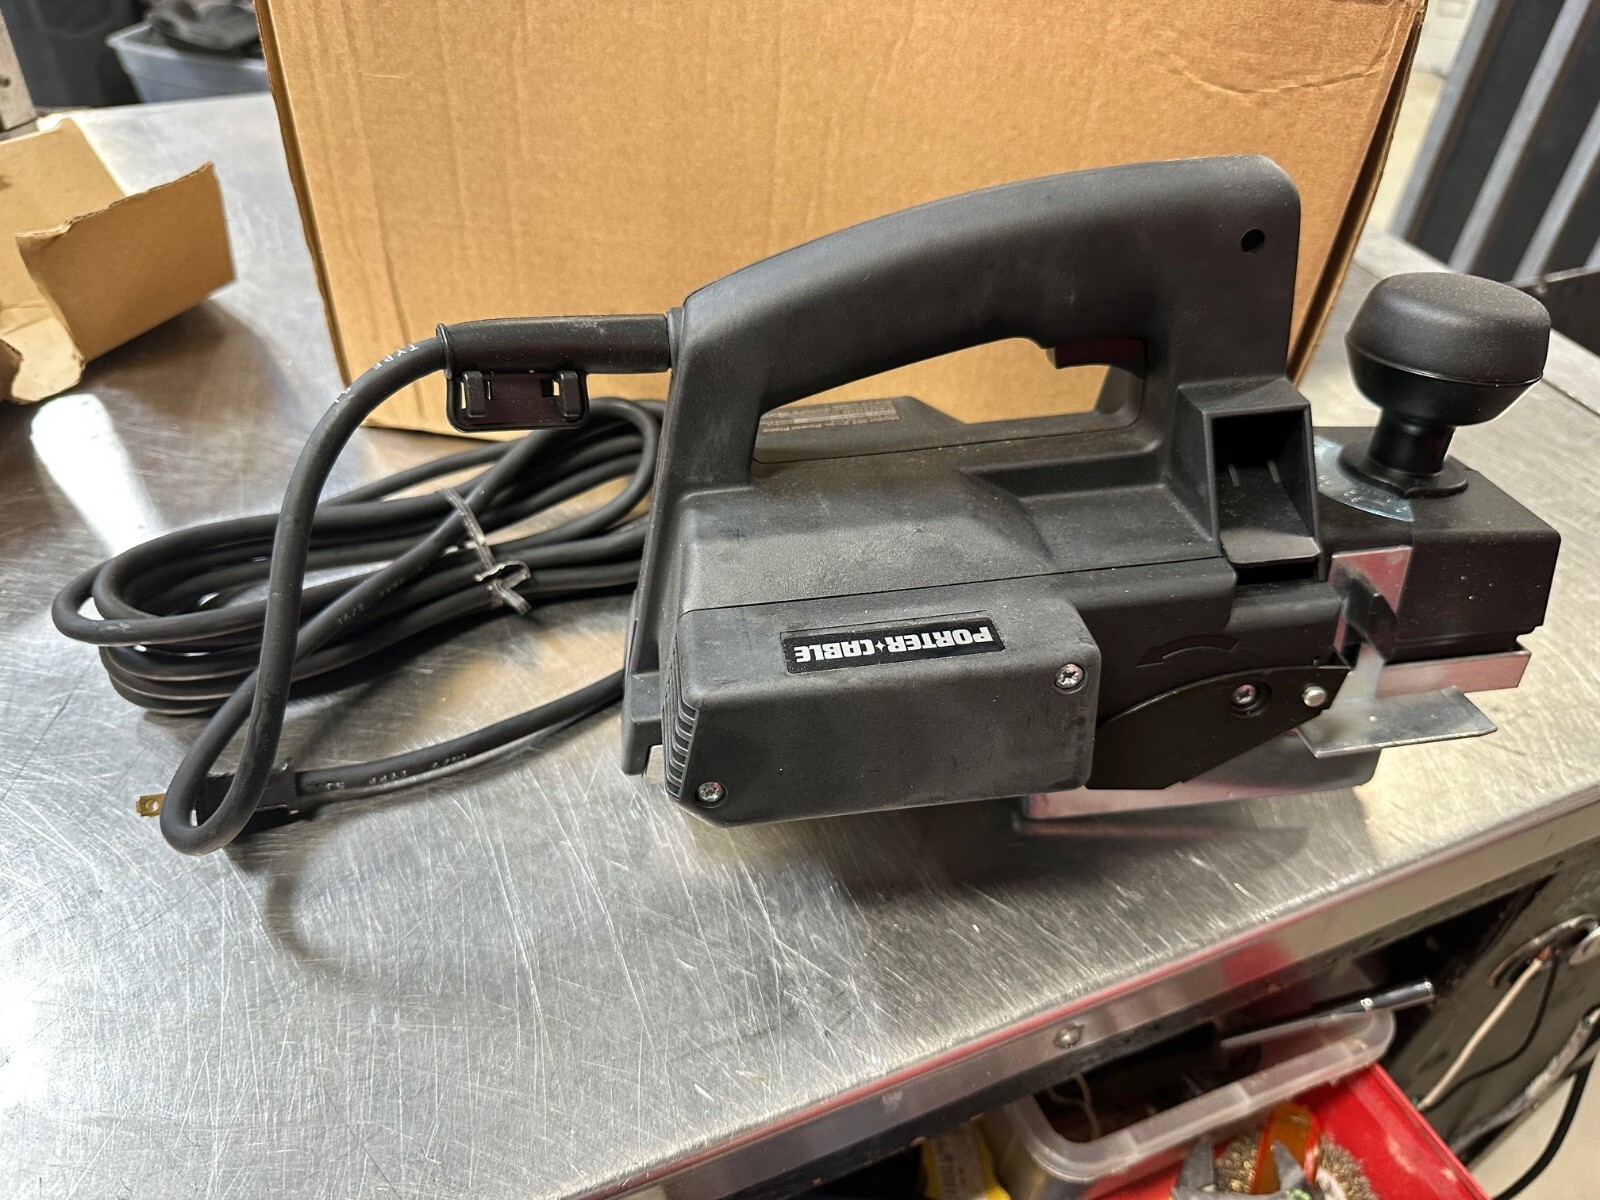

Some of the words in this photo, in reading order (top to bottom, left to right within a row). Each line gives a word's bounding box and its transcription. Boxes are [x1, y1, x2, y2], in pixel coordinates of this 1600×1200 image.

[374, 344, 419, 370] TYPE
[794, 639, 876, 663] CABLE
[885, 626, 994, 653] PORTER
